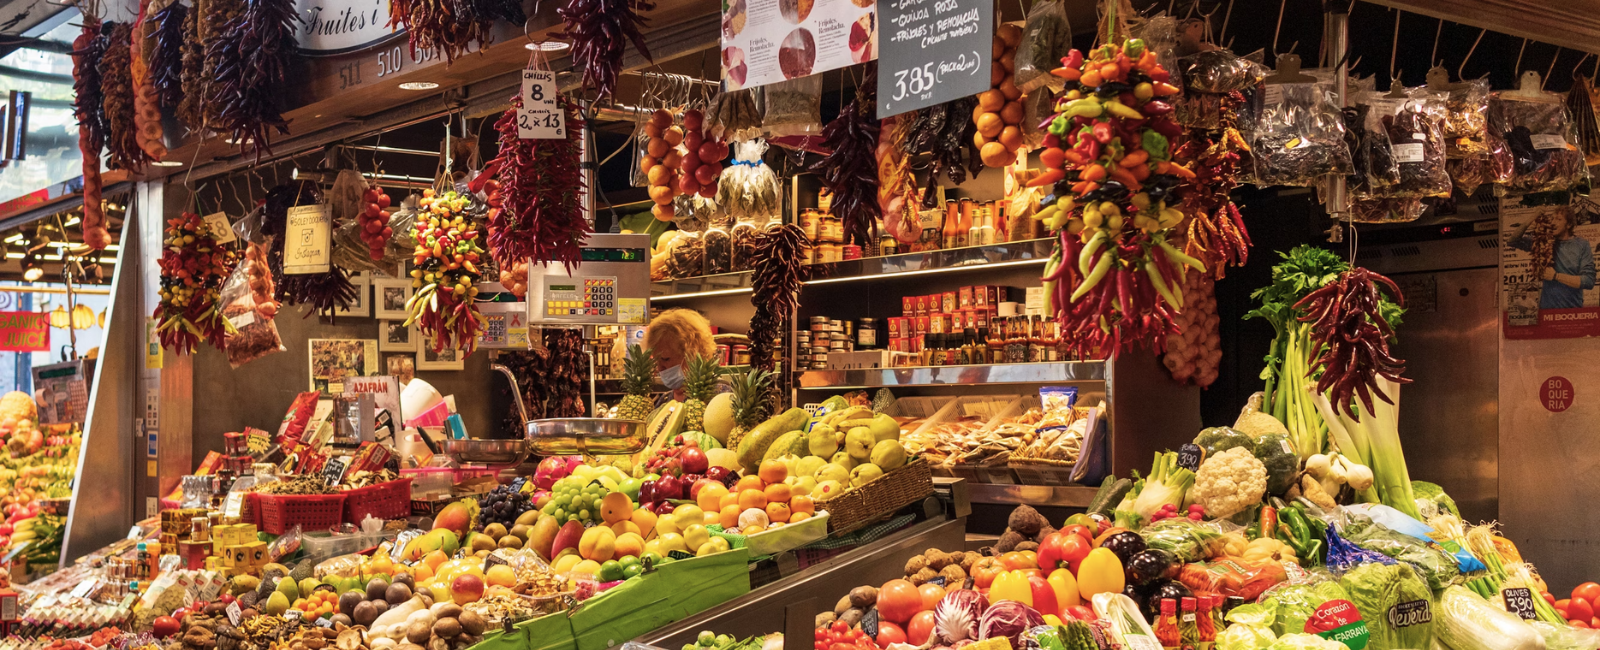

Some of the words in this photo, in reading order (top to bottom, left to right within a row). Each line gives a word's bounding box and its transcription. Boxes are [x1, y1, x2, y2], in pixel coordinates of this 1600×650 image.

[305, 6, 366, 36] Fruites
[377, 46, 403, 77] 510
[892, 62, 935, 102] 3.85
[531, 83, 544, 101] 8
[542, 113, 560, 129] 13
[1555, 312, 1599, 321] BOQUERIA
[3, 332, 46, 347] JUICE
[1548, 380, 1562, 389] BO
[1548, 390, 1569, 399] QUE
[1548, 400, 1566, 409] RIA
[1316, 602, 1350, 619] Corazón
[1337, 617, 1348, 626] de
